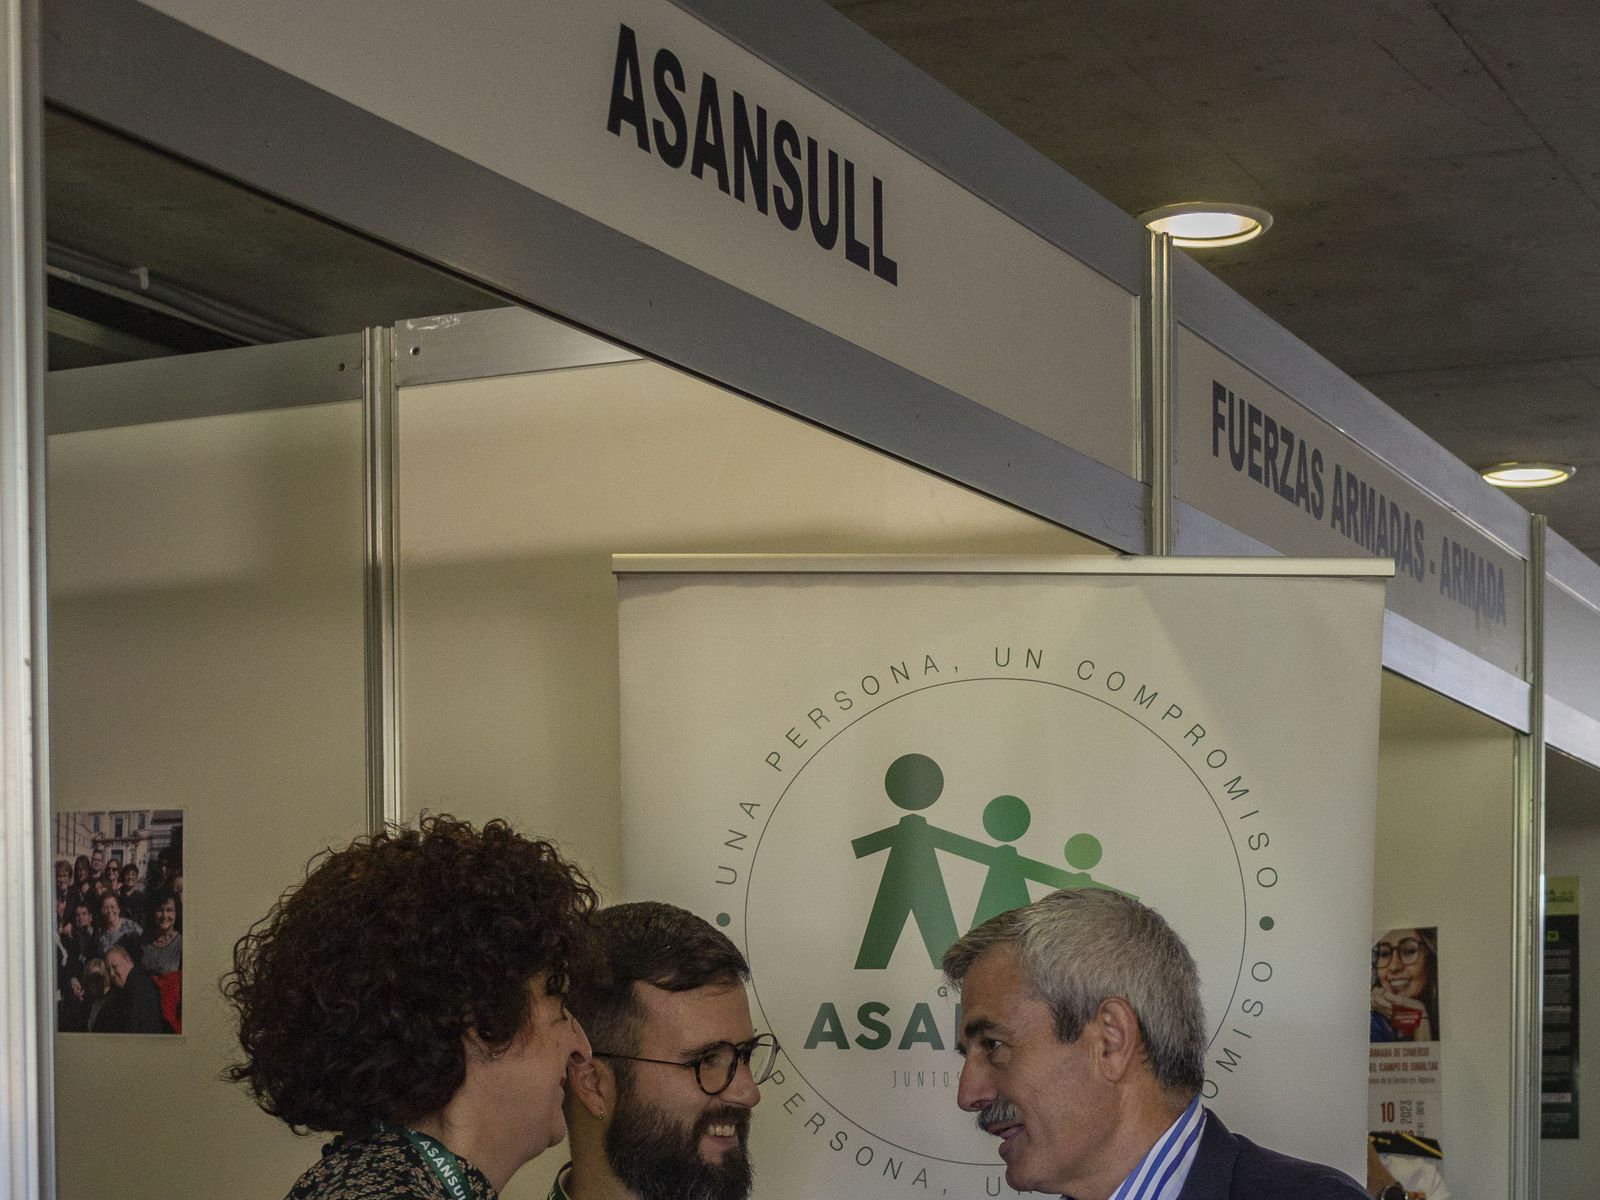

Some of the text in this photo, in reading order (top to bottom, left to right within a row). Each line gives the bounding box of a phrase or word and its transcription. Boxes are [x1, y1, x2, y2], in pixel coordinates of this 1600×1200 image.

[607, 23, 898, 287] ASANSULL
[1212, 380, 1324, 521] FUERZAS
[1331, 464, 1424, 583] ARMADAS
[1440, 536, 1507, 627] ARMADA
[715, 647, 1278, 890] UNA PERSONA, UN COMPROMISO
[892, 1071, 960, 1089] JUNTO
[1200, 961, 1273, 1099] OMISO
[1380, 1101, 1395, 1123] 10
[1400, 1099, 1412, 1124] 2023
